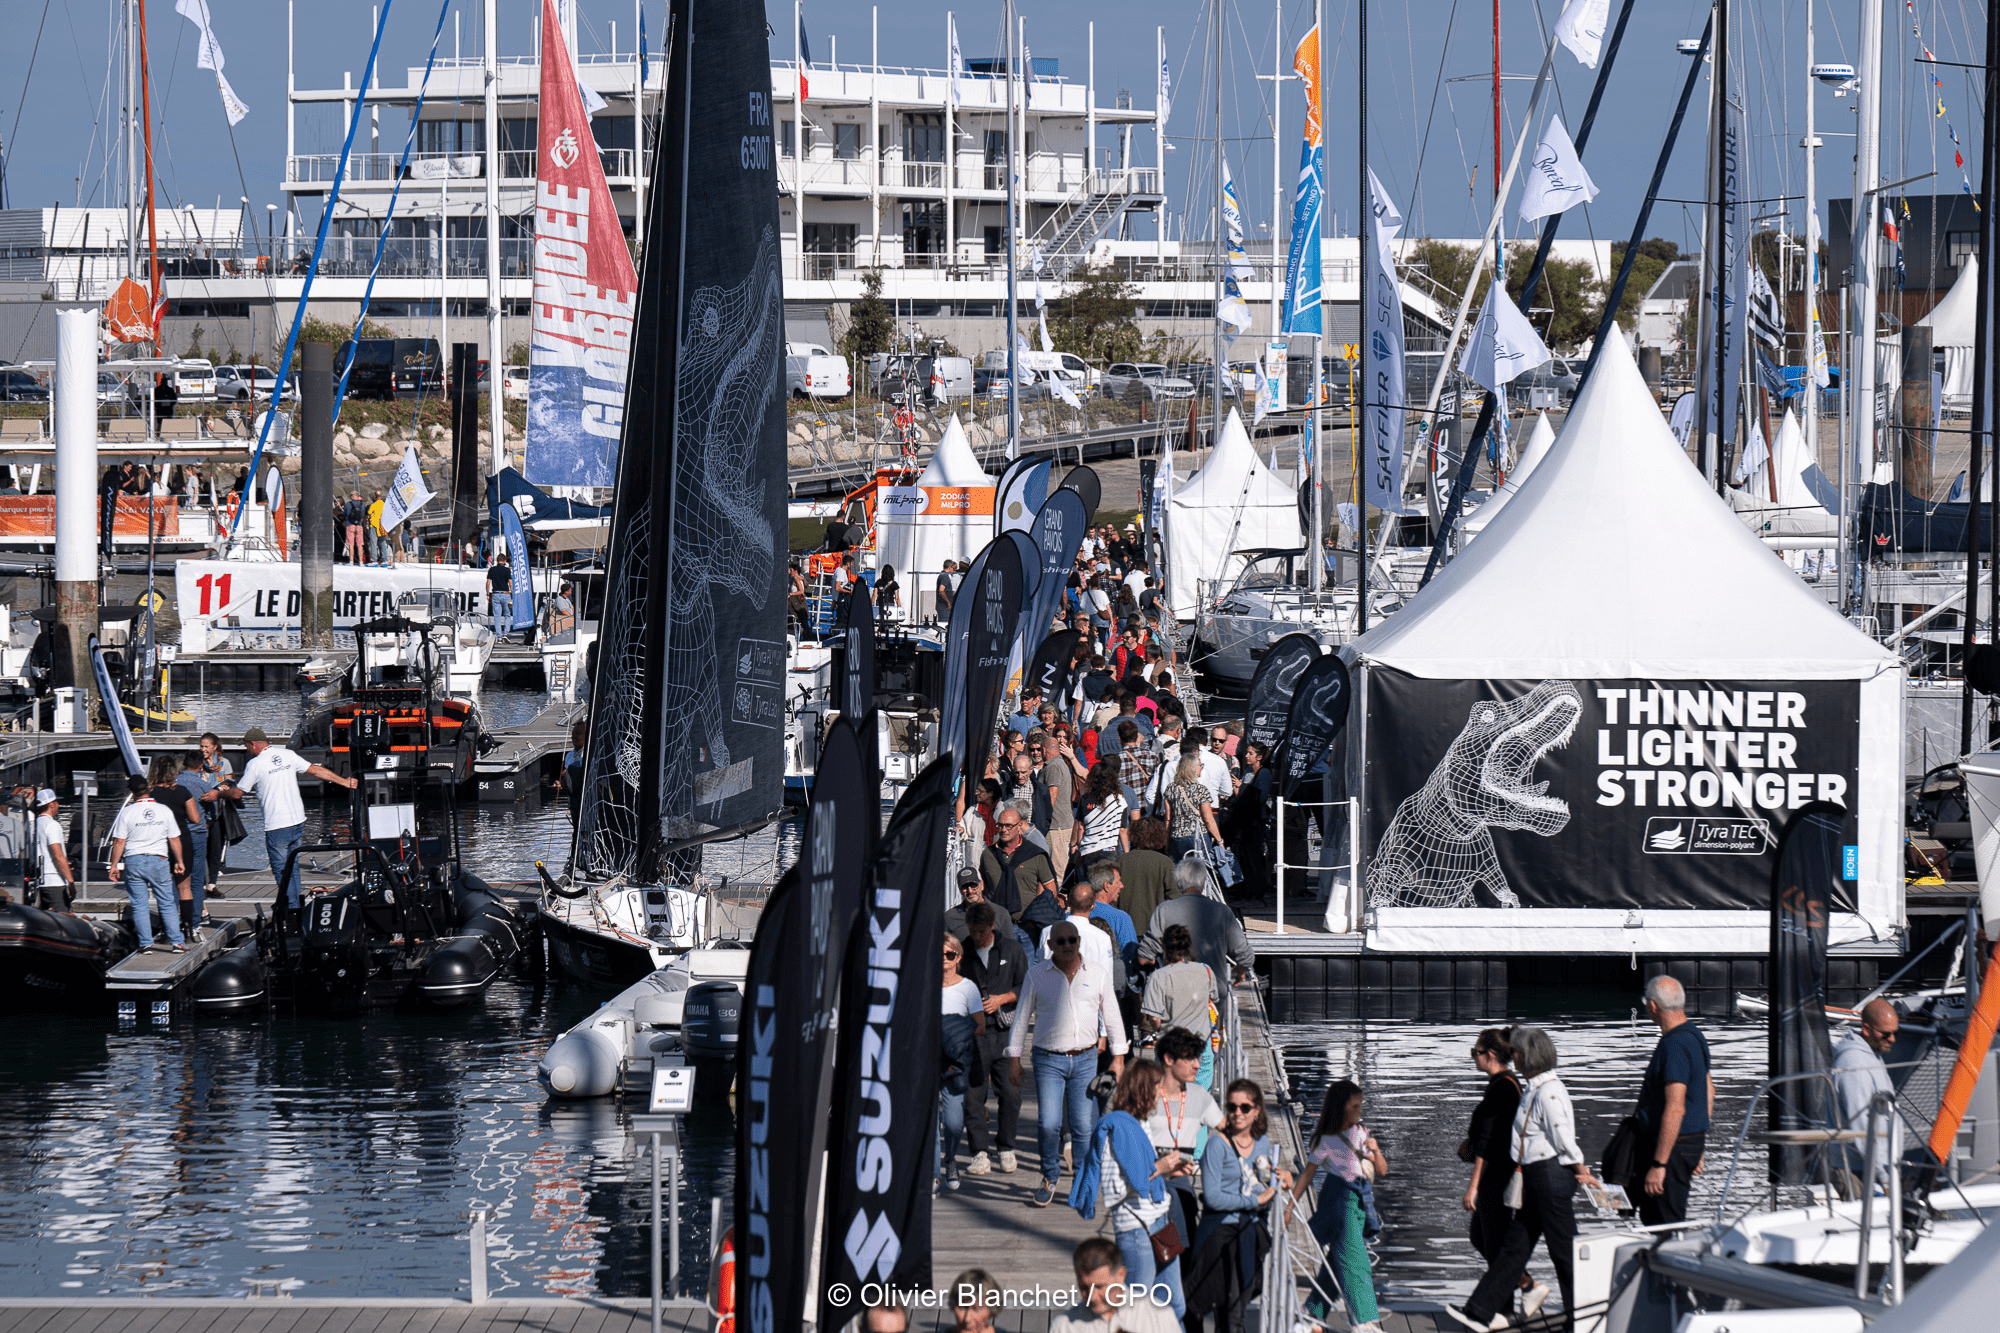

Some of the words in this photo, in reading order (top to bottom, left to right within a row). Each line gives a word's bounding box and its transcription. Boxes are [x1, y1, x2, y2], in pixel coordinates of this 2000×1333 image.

[749, 91, 769, 126] FRA
[741, 135, 770, 170] 65007
[532, 179, 590, 368] VENDEE
[581, 280, 637, 440] GLOBE
[1377, 370, 1392, 493] SAFFIER
[940, 501, 971, 509] MILPRO
[1044, 508, 1063, 531] GRAND
[1043, 531, 1063, 553] PAVOIS
[196, 573, 232, 618] 11
[255, 589, 280, 617] LE
[1597, 688, 1807, 728] THINNER
[365, 718, 373, 734] 200
[1251, 728, 1275, 738] thinner
[1597, 729, 1798, 769] LIGHTER
[479, 781, 489, 790] 54
[503, 781, 514, 790] 52
[1595, 769, 1848, 810] STRONGER
[1694, 840, 1756, 849] dimension-polyant
[1697, 823, 1729, 841] Tyra
[1846, 848, 1855, 877] SIOEN
[320, 903, 332, 926] 200
[120, 1003, 136, 1012] 58
[153, 1003, 168, 1012] 56
[686, 1004, 710, 1016] YAMAHA
[856, 887, 903, 1196] SUZUKI
[749, 985, 777, 1333] SUZUKI
